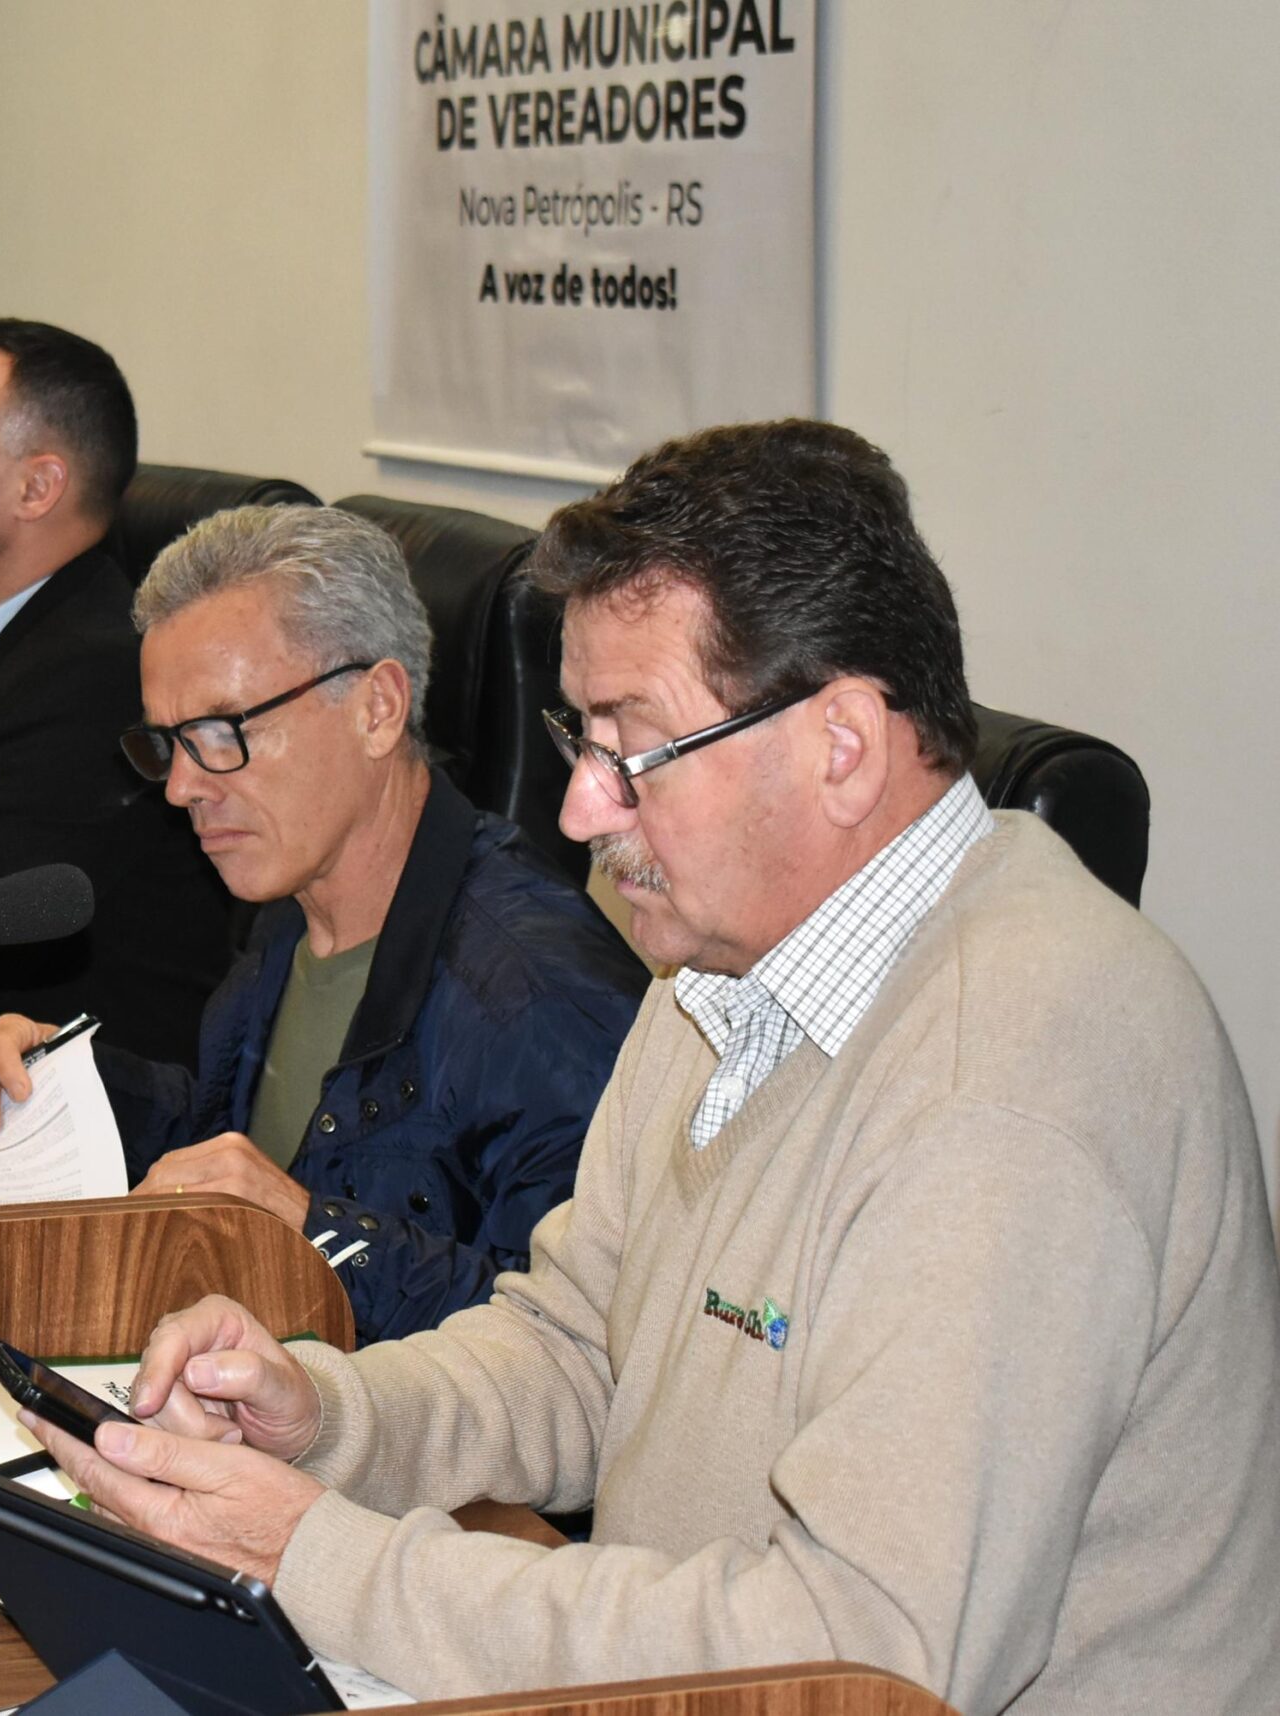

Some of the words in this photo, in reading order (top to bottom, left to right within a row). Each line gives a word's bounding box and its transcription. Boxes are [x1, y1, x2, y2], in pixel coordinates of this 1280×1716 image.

[415, 12, 551, 84] CÂMARA
[562, 0, 794, 71] MUNICIPAL
[436, 96, 477, 152] DE
[487, 74, 746, 149] VEREADORES
[459, 187, 515, 227] Nova
[523, 181, 643, 238] Petrópolis
[666, 181, 703, 227] RS
[478, 263, 499, 302] A
[504, 272, 545, 304] voz
[552, 262, 583, 306] de
[591, 263, 678, 310] todos!
